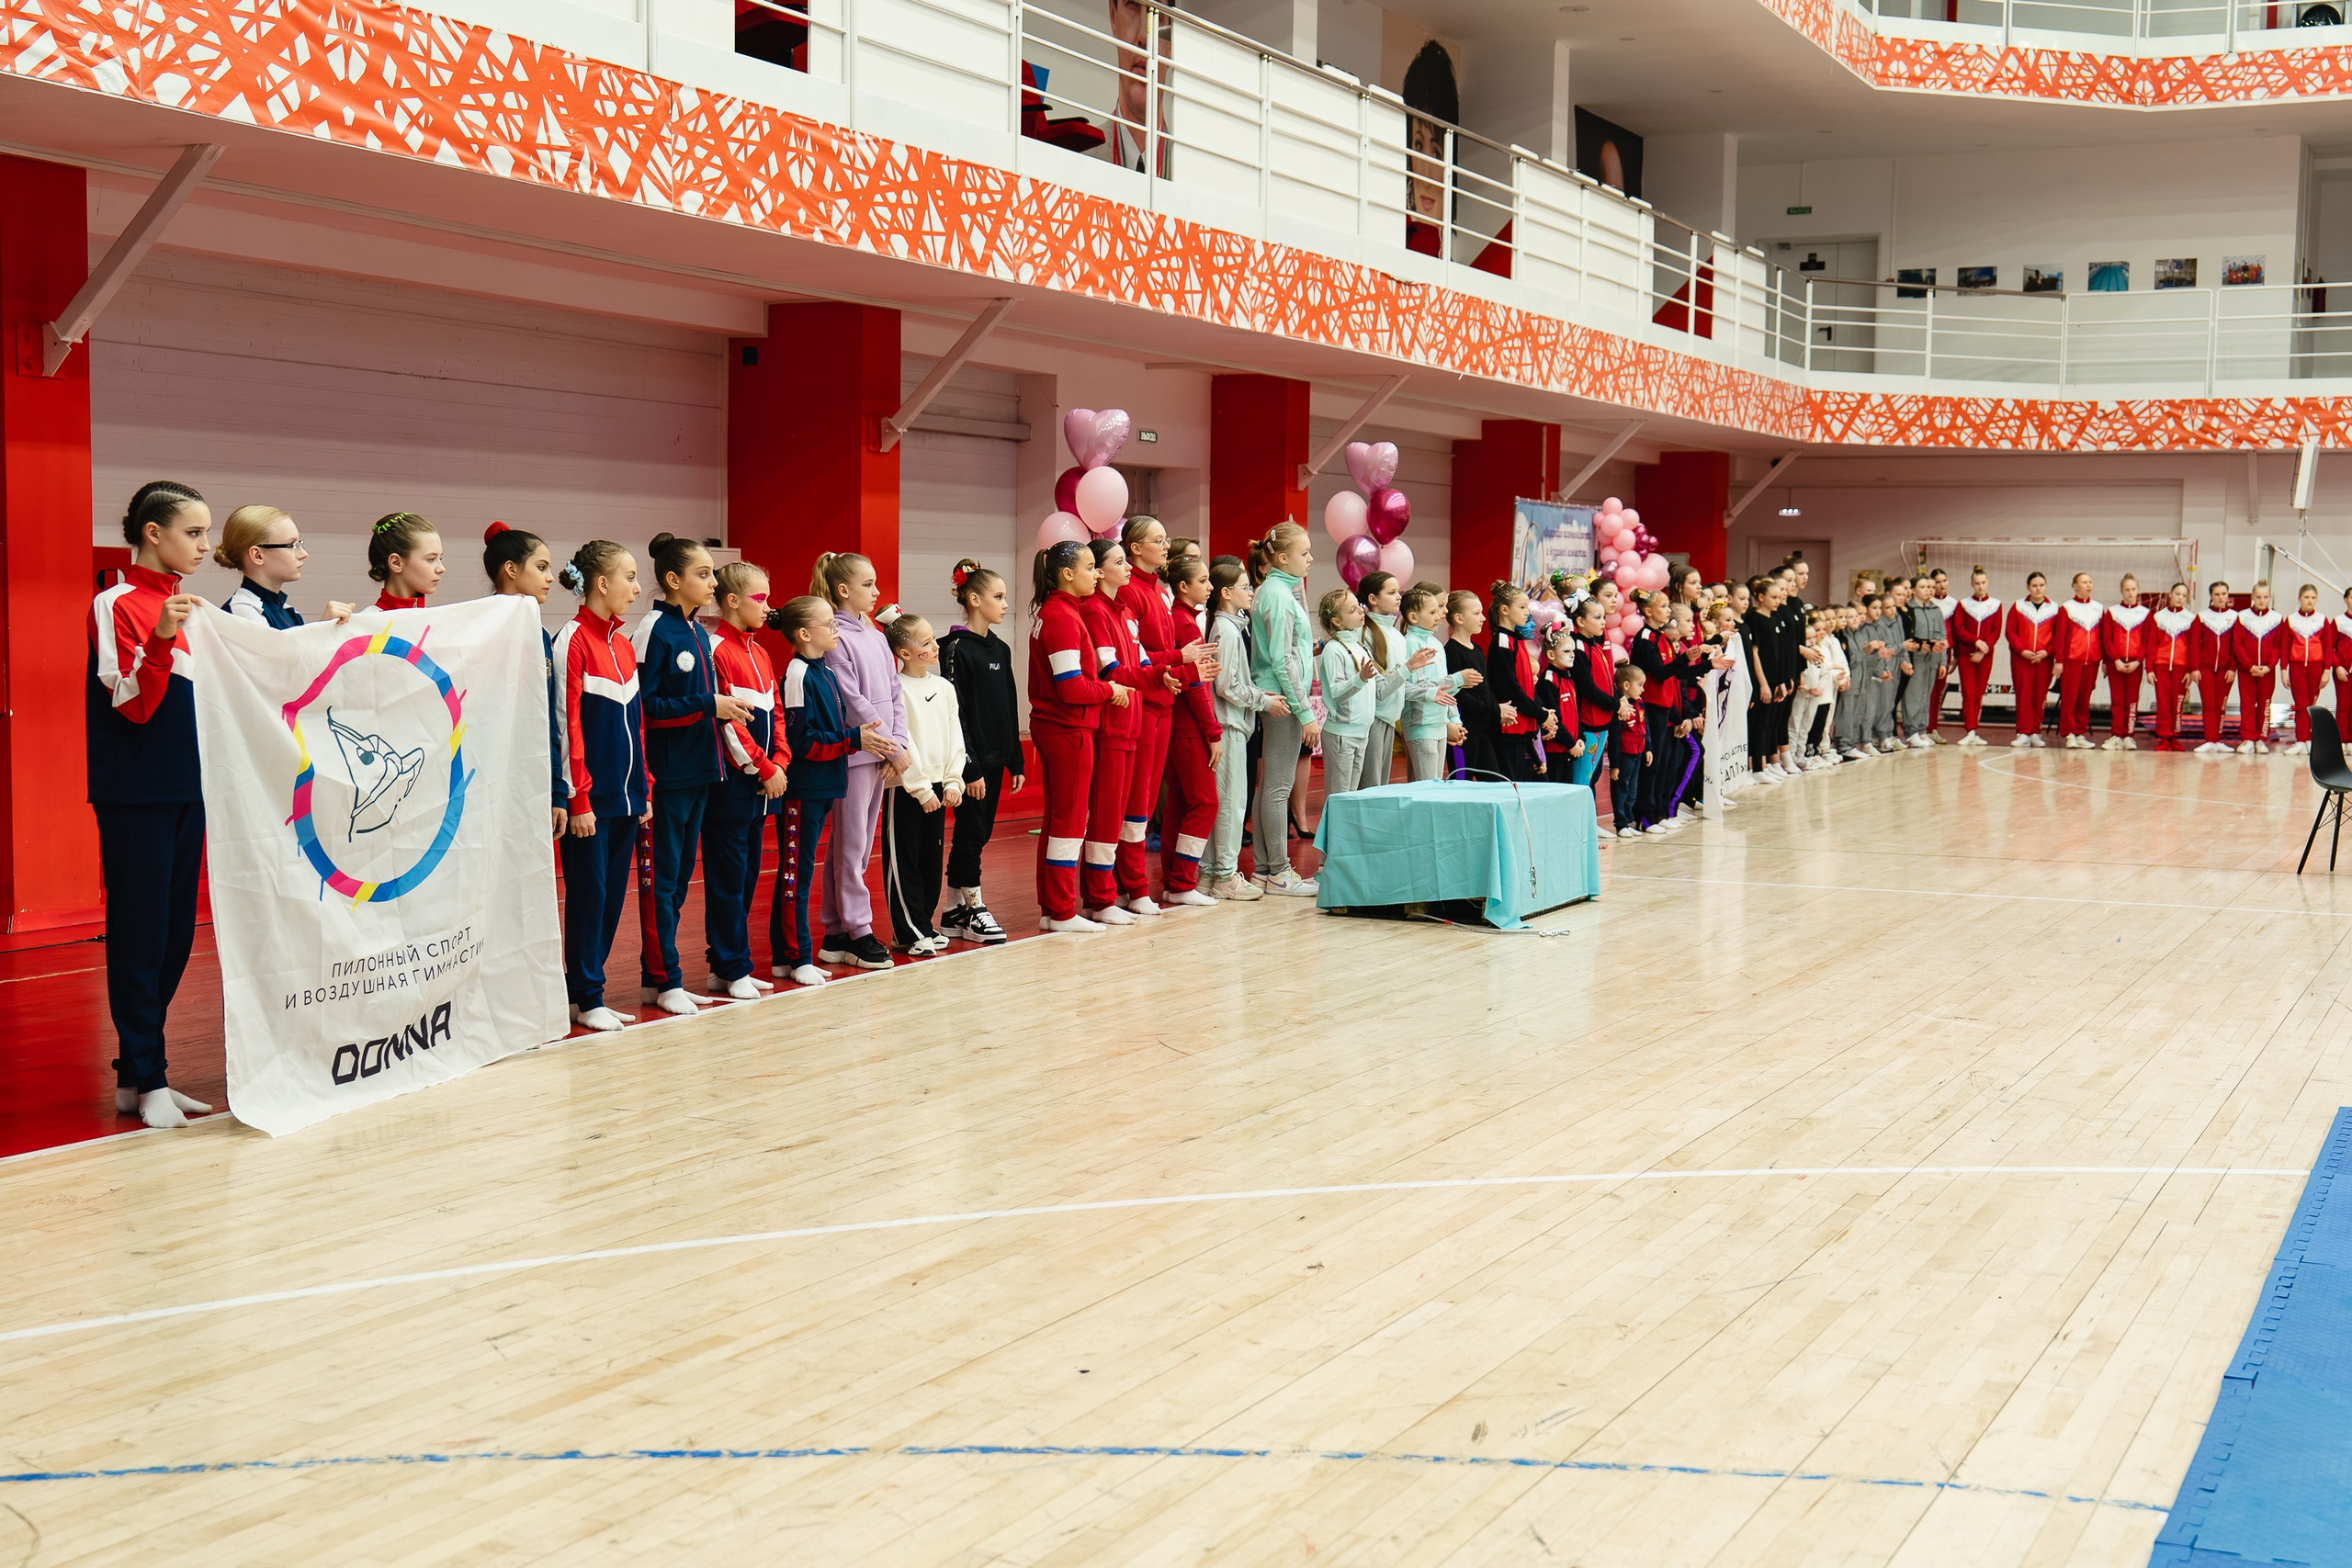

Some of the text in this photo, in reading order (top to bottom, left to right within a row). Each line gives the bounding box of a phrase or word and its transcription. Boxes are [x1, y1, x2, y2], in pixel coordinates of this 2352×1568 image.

[285, 938, 484, 1010] И ВОЗДУШНАЯ ГИМНАСТИ
[332, 926, 471, 978] ПИЛОННЫЙ СПОРТ
